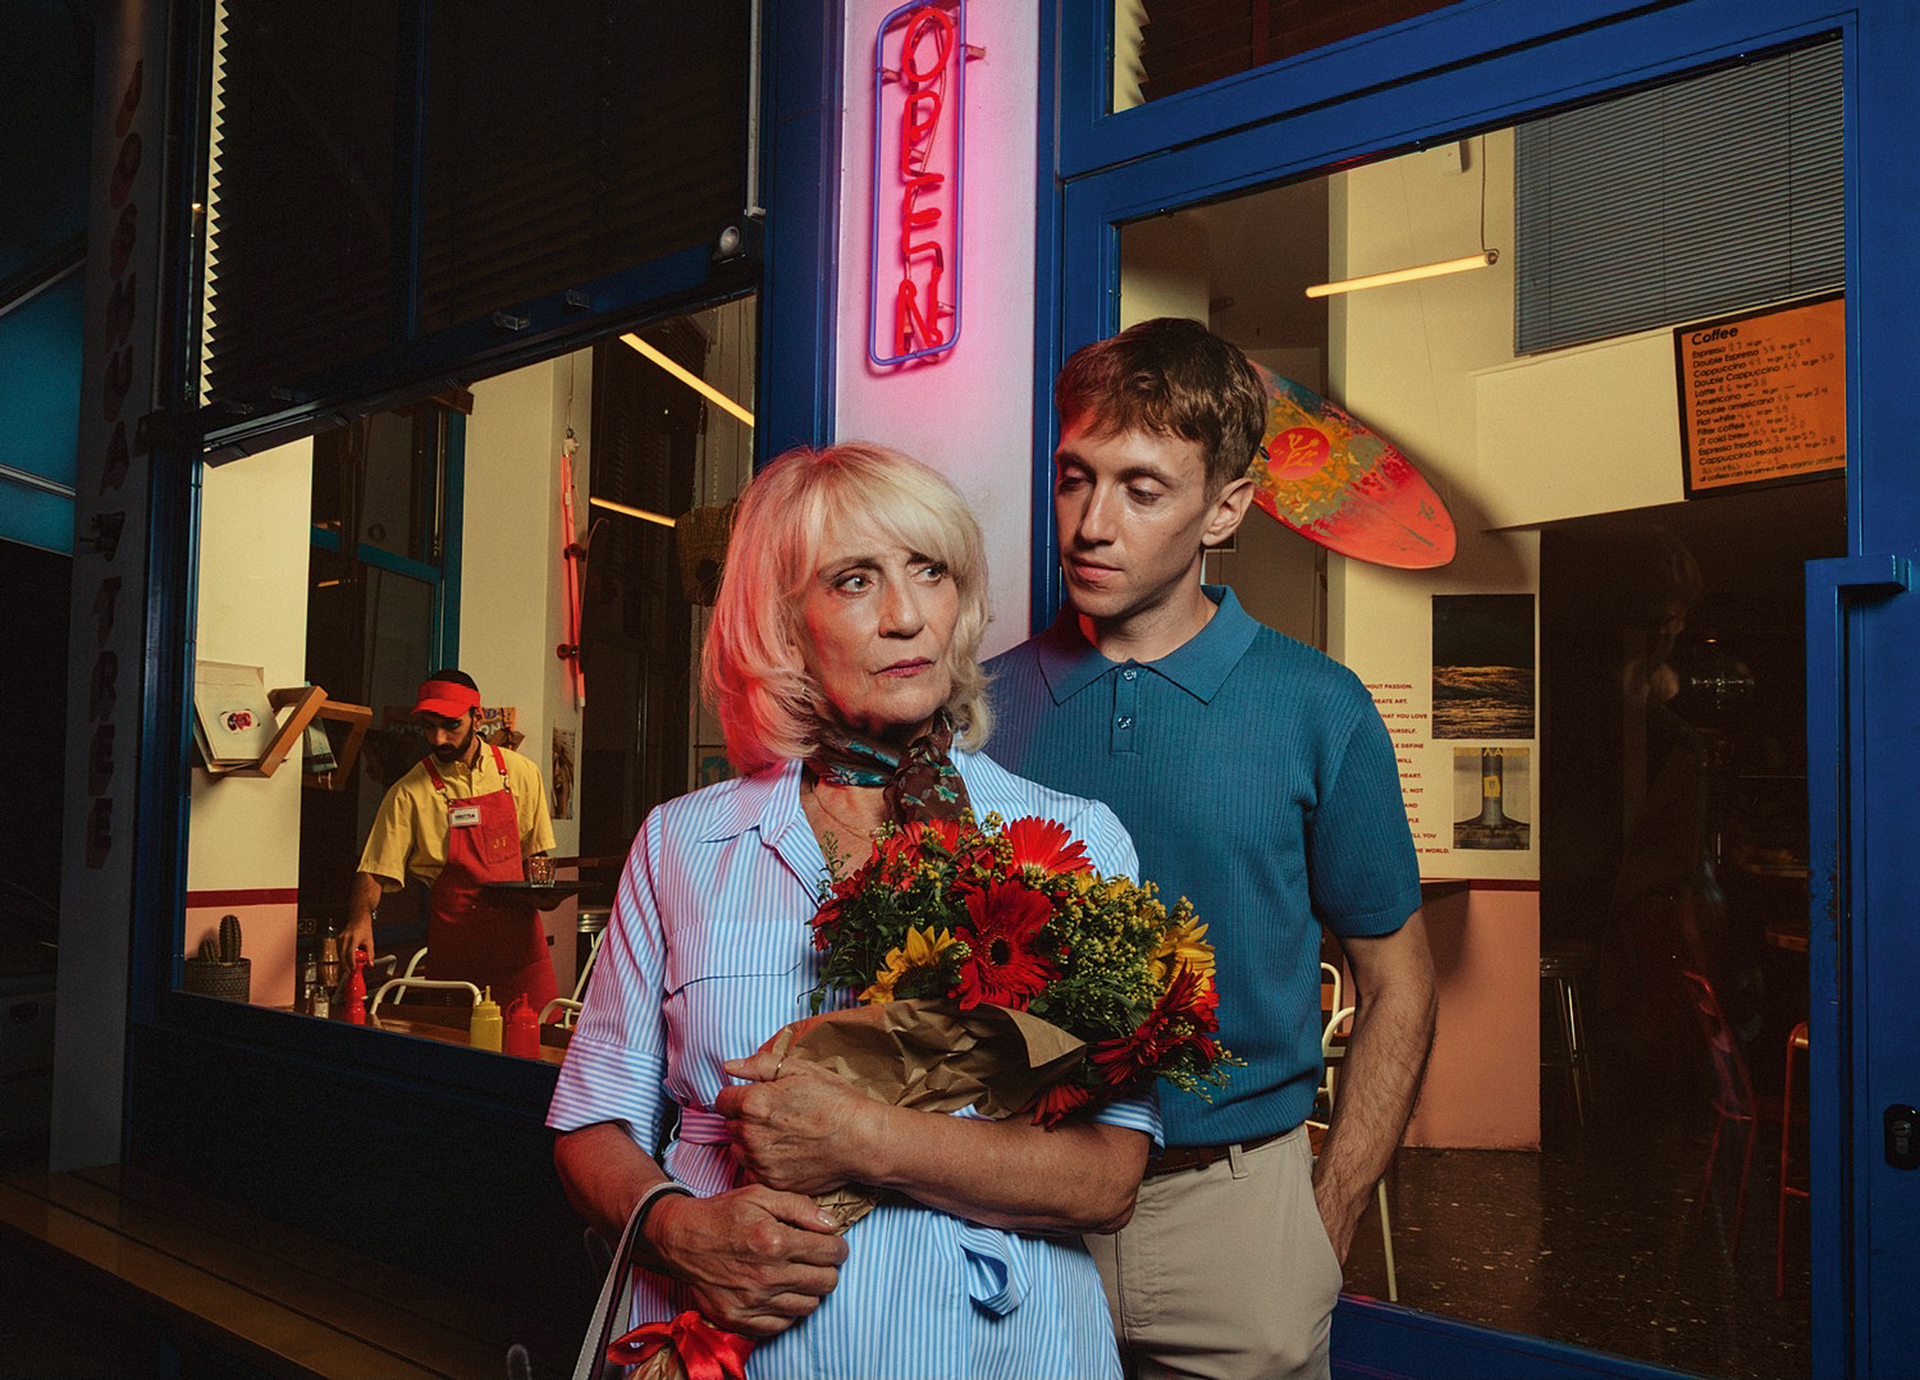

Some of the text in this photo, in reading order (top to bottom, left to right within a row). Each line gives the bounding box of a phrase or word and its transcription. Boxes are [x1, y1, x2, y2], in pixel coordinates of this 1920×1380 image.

[895, 9, 952, 357] OPEN
[1692, 327, 1739, 346] Coffee
[1693, 357, 1723, 368] Double
[1725, 350, 1759, 362] Espresso
[1693, 362, 1747, 378] Cappuccino
[1694, 377, 1724, 388] Double
[1725, 366, 1780, 381] Cappuccino
[1695, 388, 1716, 398] Latte
[1696, 394, 1741, 406] Americano
[1696, 406, 1726, 417] Double
[1728, 397, 1774, 410] americano
[1713, 414, 1736, 423] white
[1717, 423, 1745, 433] coffee
[1707, 435, 1727, 444] cold
[1728, 433, 1749, 441] brew
[1698, 445, 1732, 456] Espresso
[85, 58, 144, 870] JOSHUA TREE
[1699, 452, 1752, 465] Cappuccino
[493, 836, 508, 849] JT
